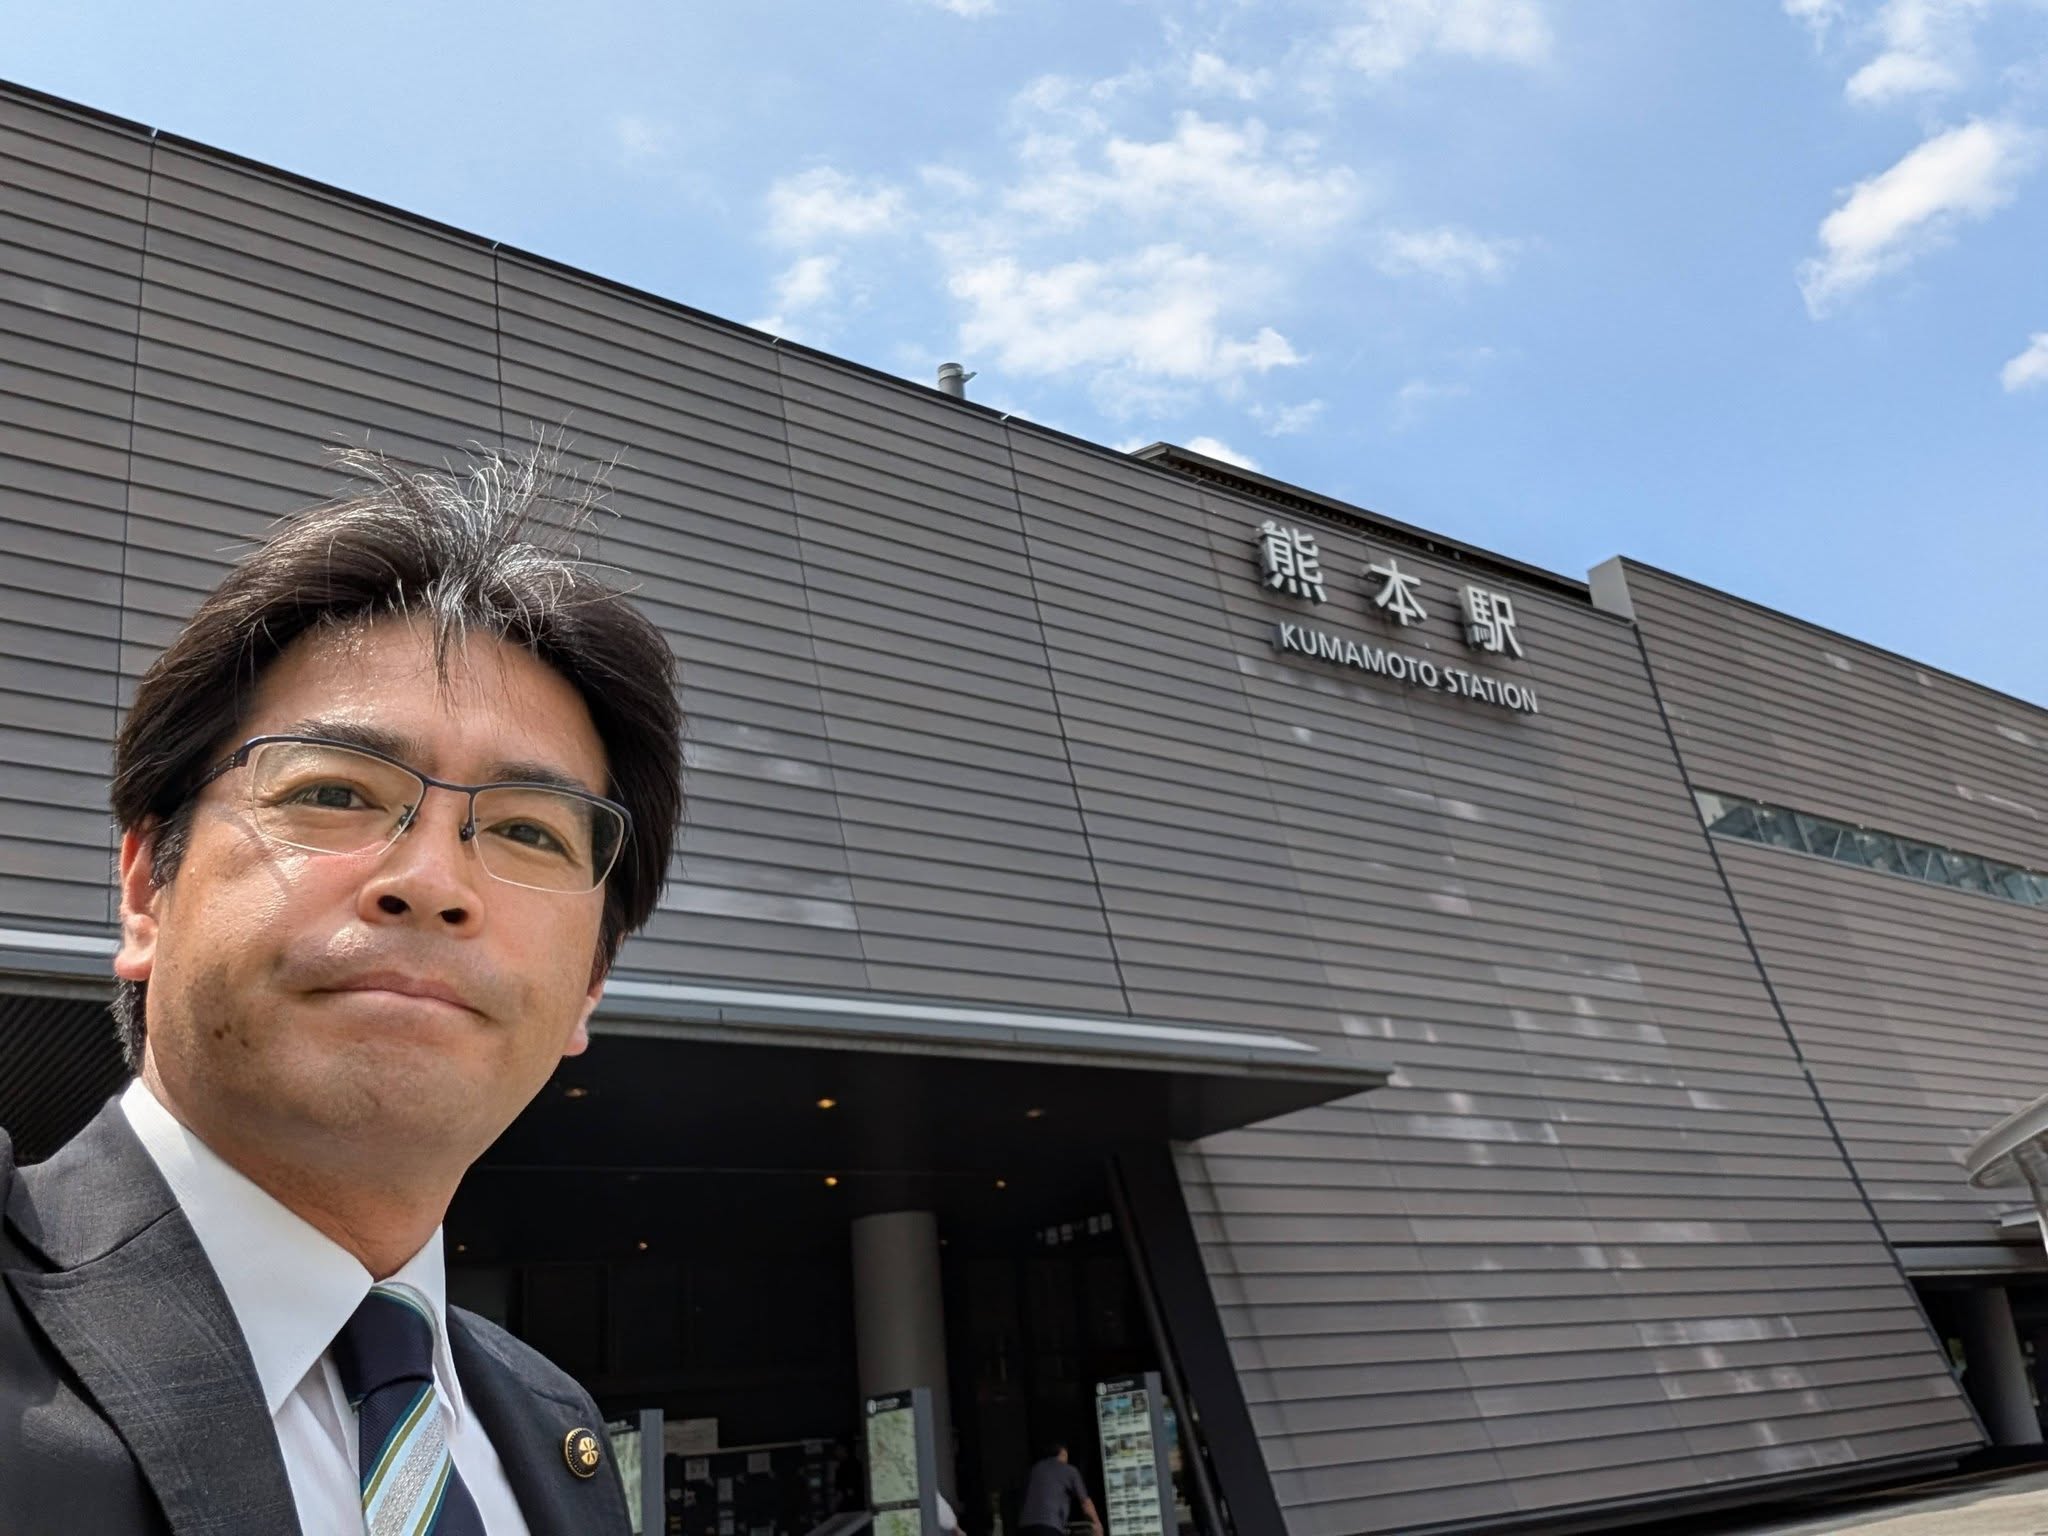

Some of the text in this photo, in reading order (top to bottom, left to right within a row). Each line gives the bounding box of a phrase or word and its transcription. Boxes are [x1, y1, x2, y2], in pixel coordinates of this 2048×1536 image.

[1260, 520, 1523, 657] 熊本駅
[1280, 622, 1539, 714] KUMAMOTO STATION
